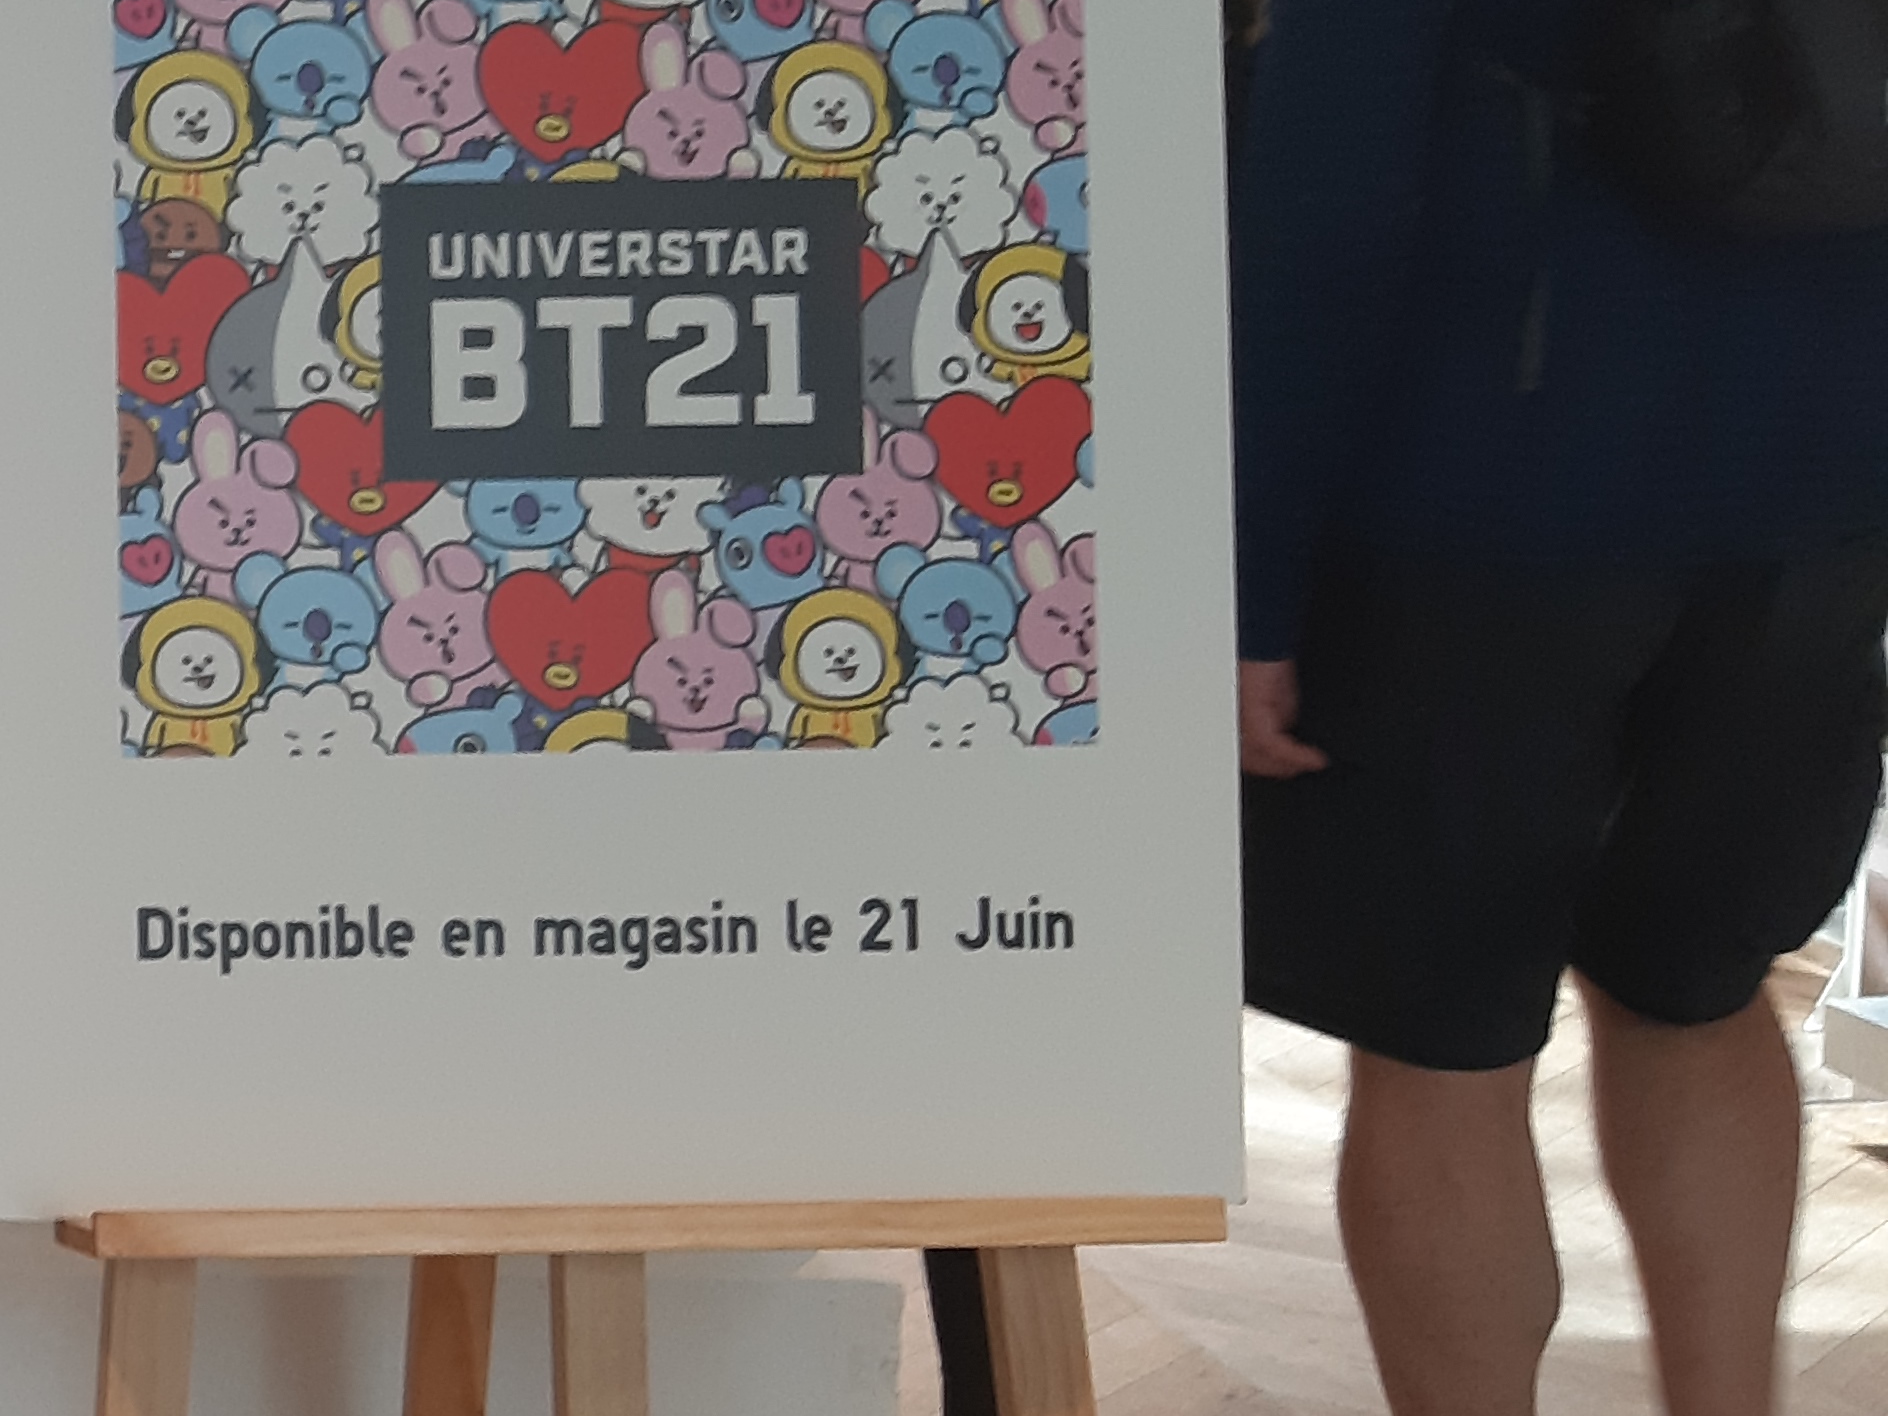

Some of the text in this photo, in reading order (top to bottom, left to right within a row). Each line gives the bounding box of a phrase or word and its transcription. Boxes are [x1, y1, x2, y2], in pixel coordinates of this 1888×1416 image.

[427, 227, 809, 280] UNIVERSTAR
[429, 292, 816, 430] BT21
[136, 894, 1076, 976] Disponible en magasin le 21 Juin
